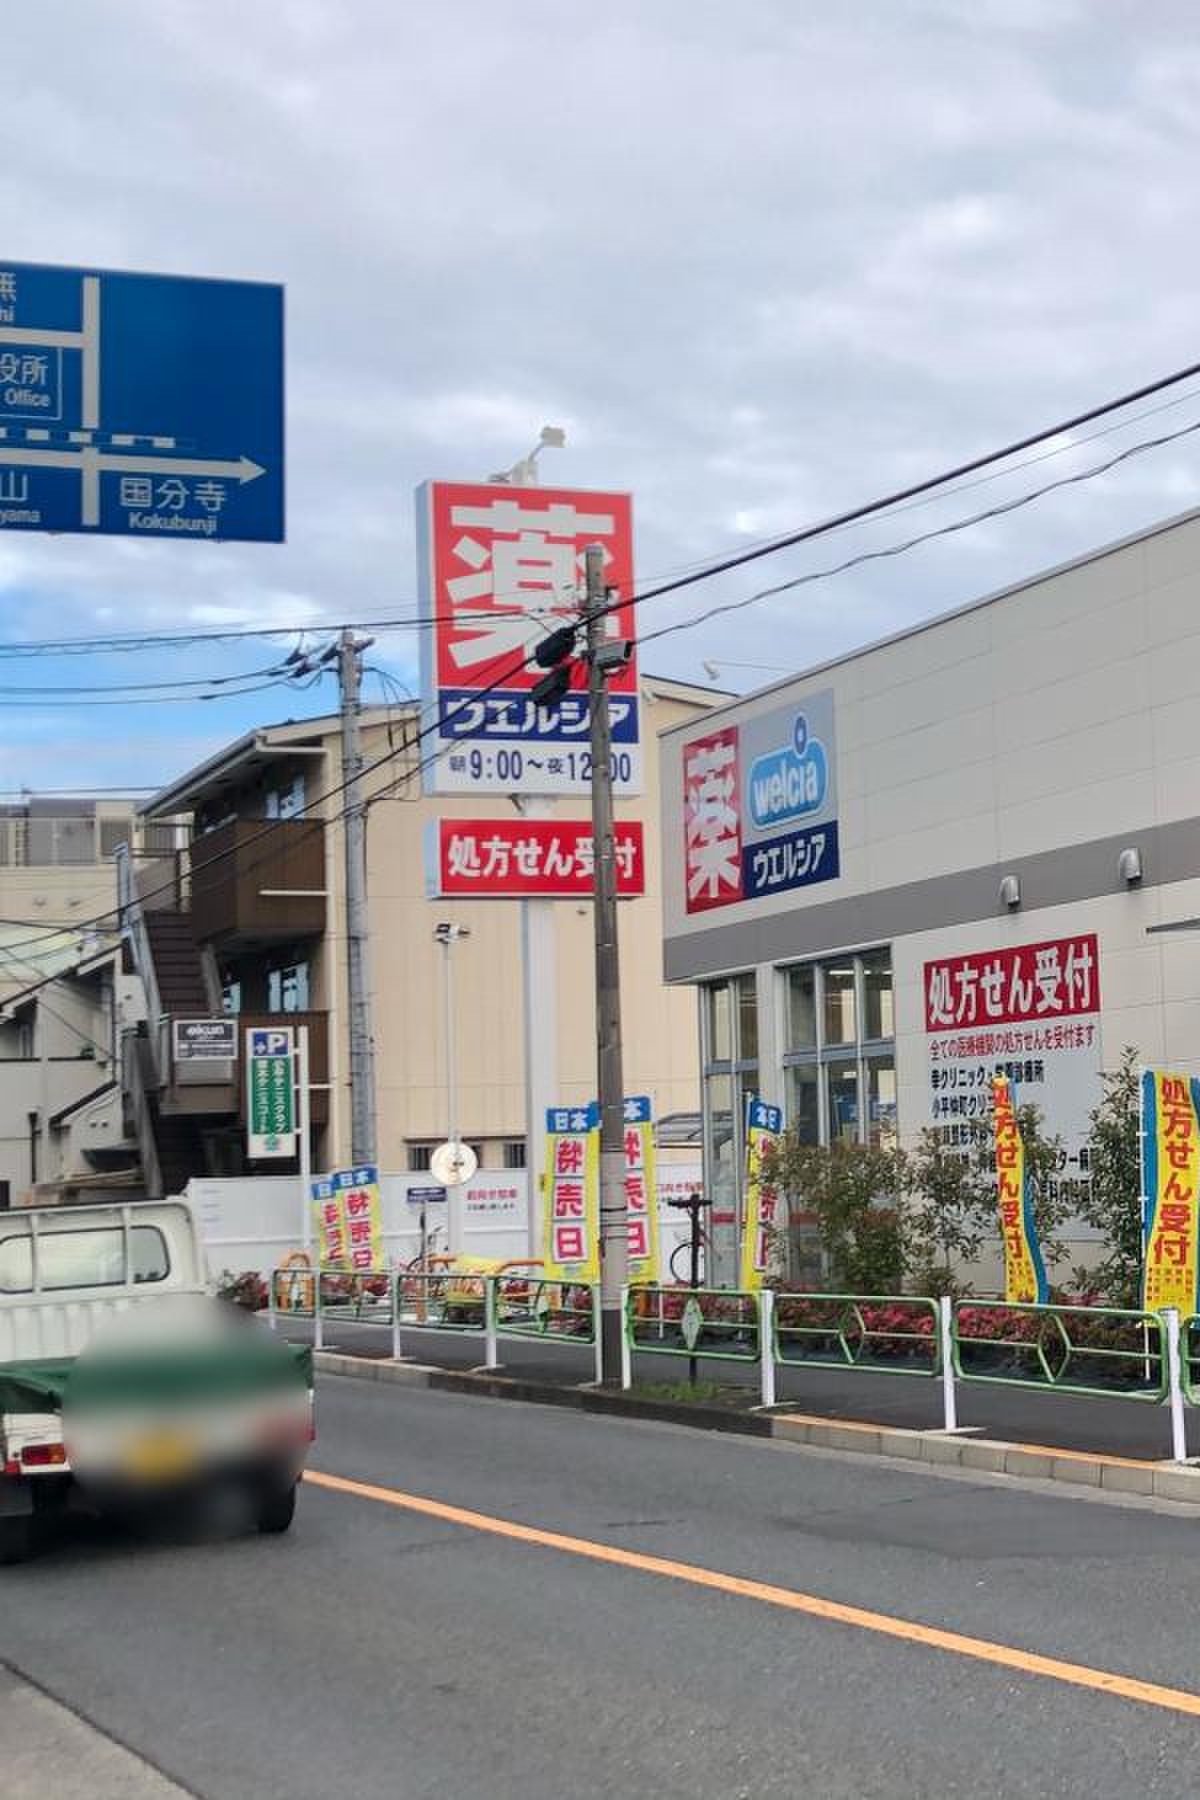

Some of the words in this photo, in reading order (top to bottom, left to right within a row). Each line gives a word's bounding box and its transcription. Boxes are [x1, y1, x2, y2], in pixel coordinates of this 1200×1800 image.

[4, 388, 50, 407] Office
[119, 478, 227, 513] 国分寺
[128, 511, 217, 534] Kokubunji
[446, 500, 620, 676] 薬
[753, 759, 819, 817] welcia
[686, 742, 741, 901] 薬
[753, 833, 826, 889] ウエルシア
[929, 943, 1093, 1025] 処方せん受付
[267, 1033, 286, 1052] P
[1153, 1076, 1195, 1267] 処方せん受付
